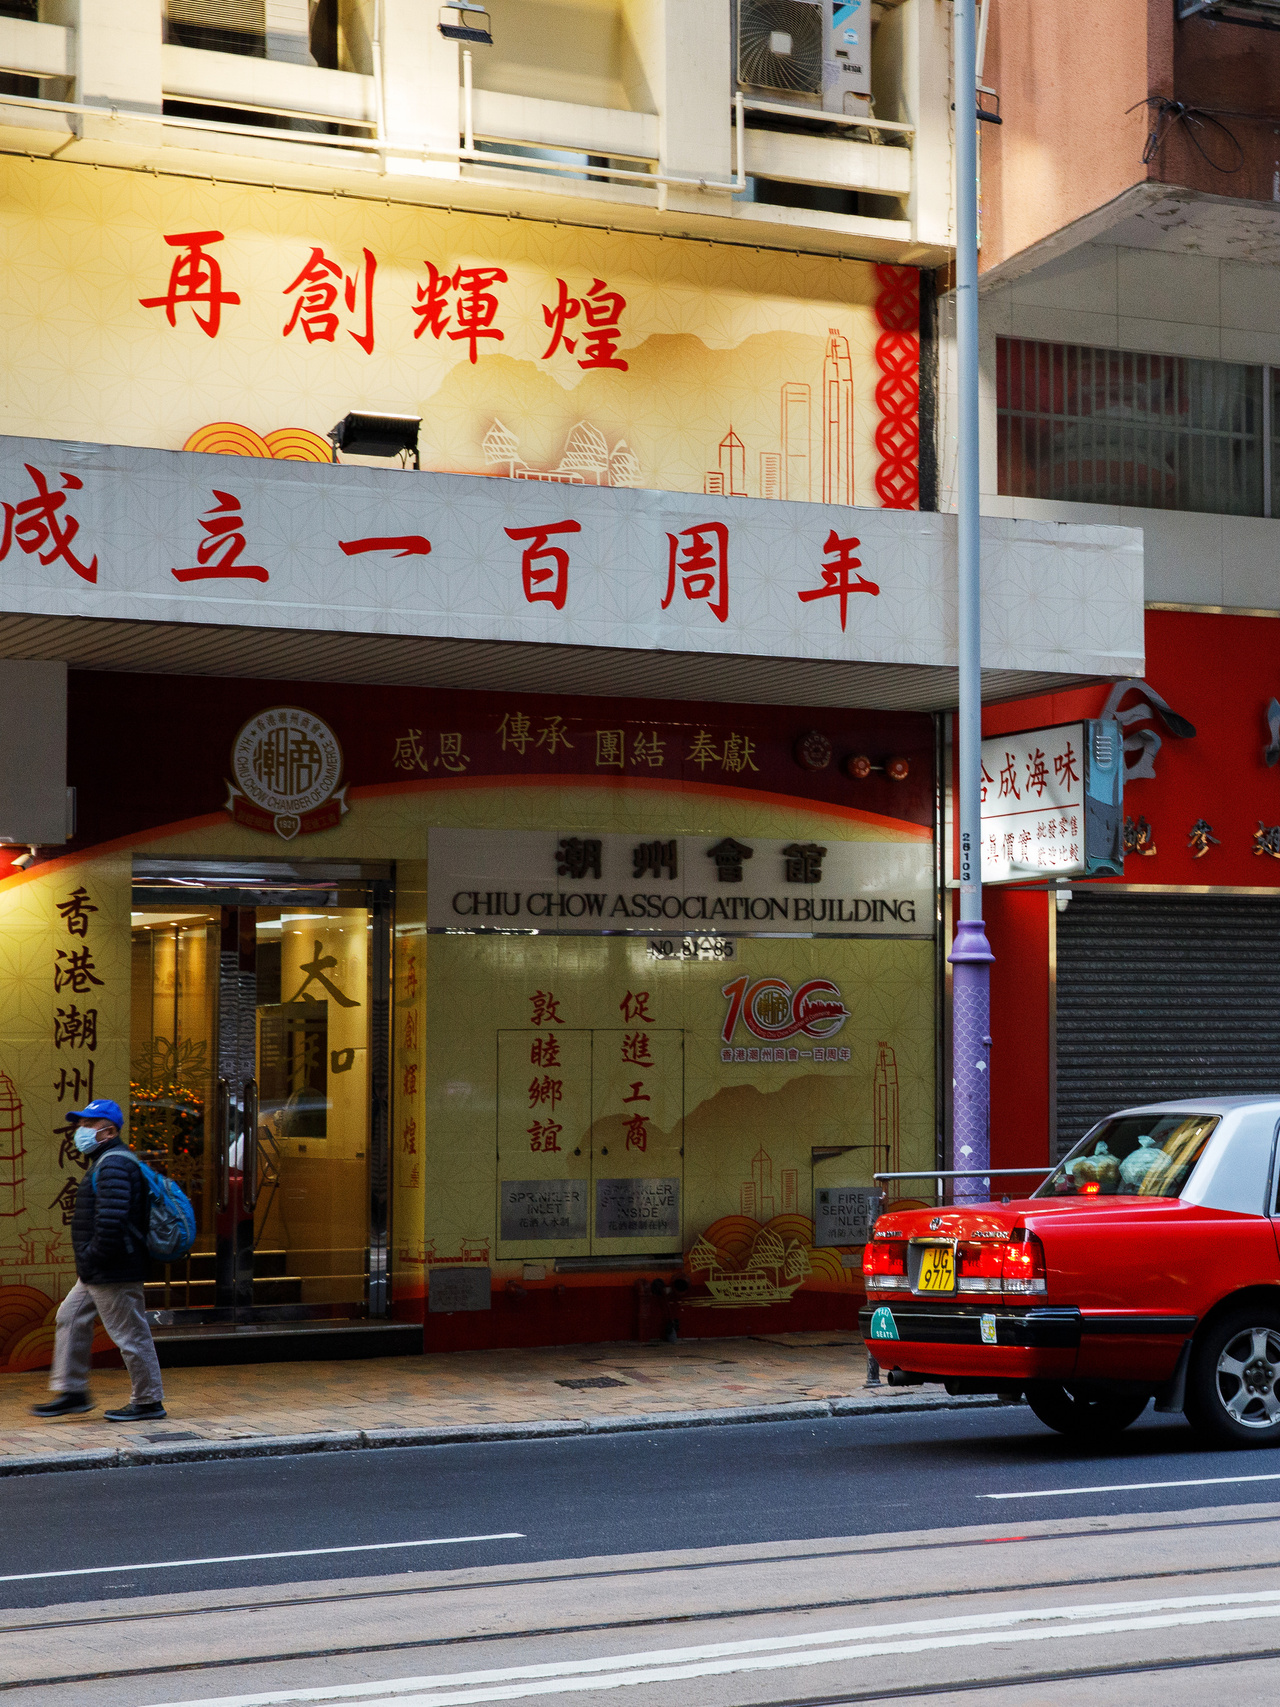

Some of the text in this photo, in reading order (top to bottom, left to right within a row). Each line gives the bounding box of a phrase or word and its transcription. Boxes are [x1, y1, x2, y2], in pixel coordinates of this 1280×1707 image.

[139, 229, 631, 373] 再創輝煌
[0, 462, 881, 634] 成立一百周年
[392, 728, 472, 773] 感恩
[496, 711, 575, 755] 傳承
[594, 728, 666, 769] 團結
[684, 729, 762, 774] 奉獻
[237, 756, 251, 779] CHIU
[318, 740, 338, 793] COMMERCE
[243, 778, 268, 803] CHOW
[311, 789, 323, 802] OF
[267, 795, 312, 812] CHAMBER
[278, 820, 297, 829] 1921
[556, 836, 828, 884] 潮州會館
[452, 891, 917, 923] CHIU CHOW ASSOCIATION BUILDING
[682, 941, 734, 957] 81-85
[721, 1047, 851, 1062] 香港潮州商會一百周年
[526, 990, 566, 1154] 敦睦鄉誼
[618, 990, 656, 1153] 促進工商
[838, 1193, 865, 1204] FIRE
[527, 1203, 563, 1215] INLET
[836, 1215, 868, 1226] NLET
[932, 1249, 949, 1269] UG
[924, 1269, 952, 1289] 9717
[880, 1318, 887, 1330] 4
[876, 1330, 894, 1339] SEATS
